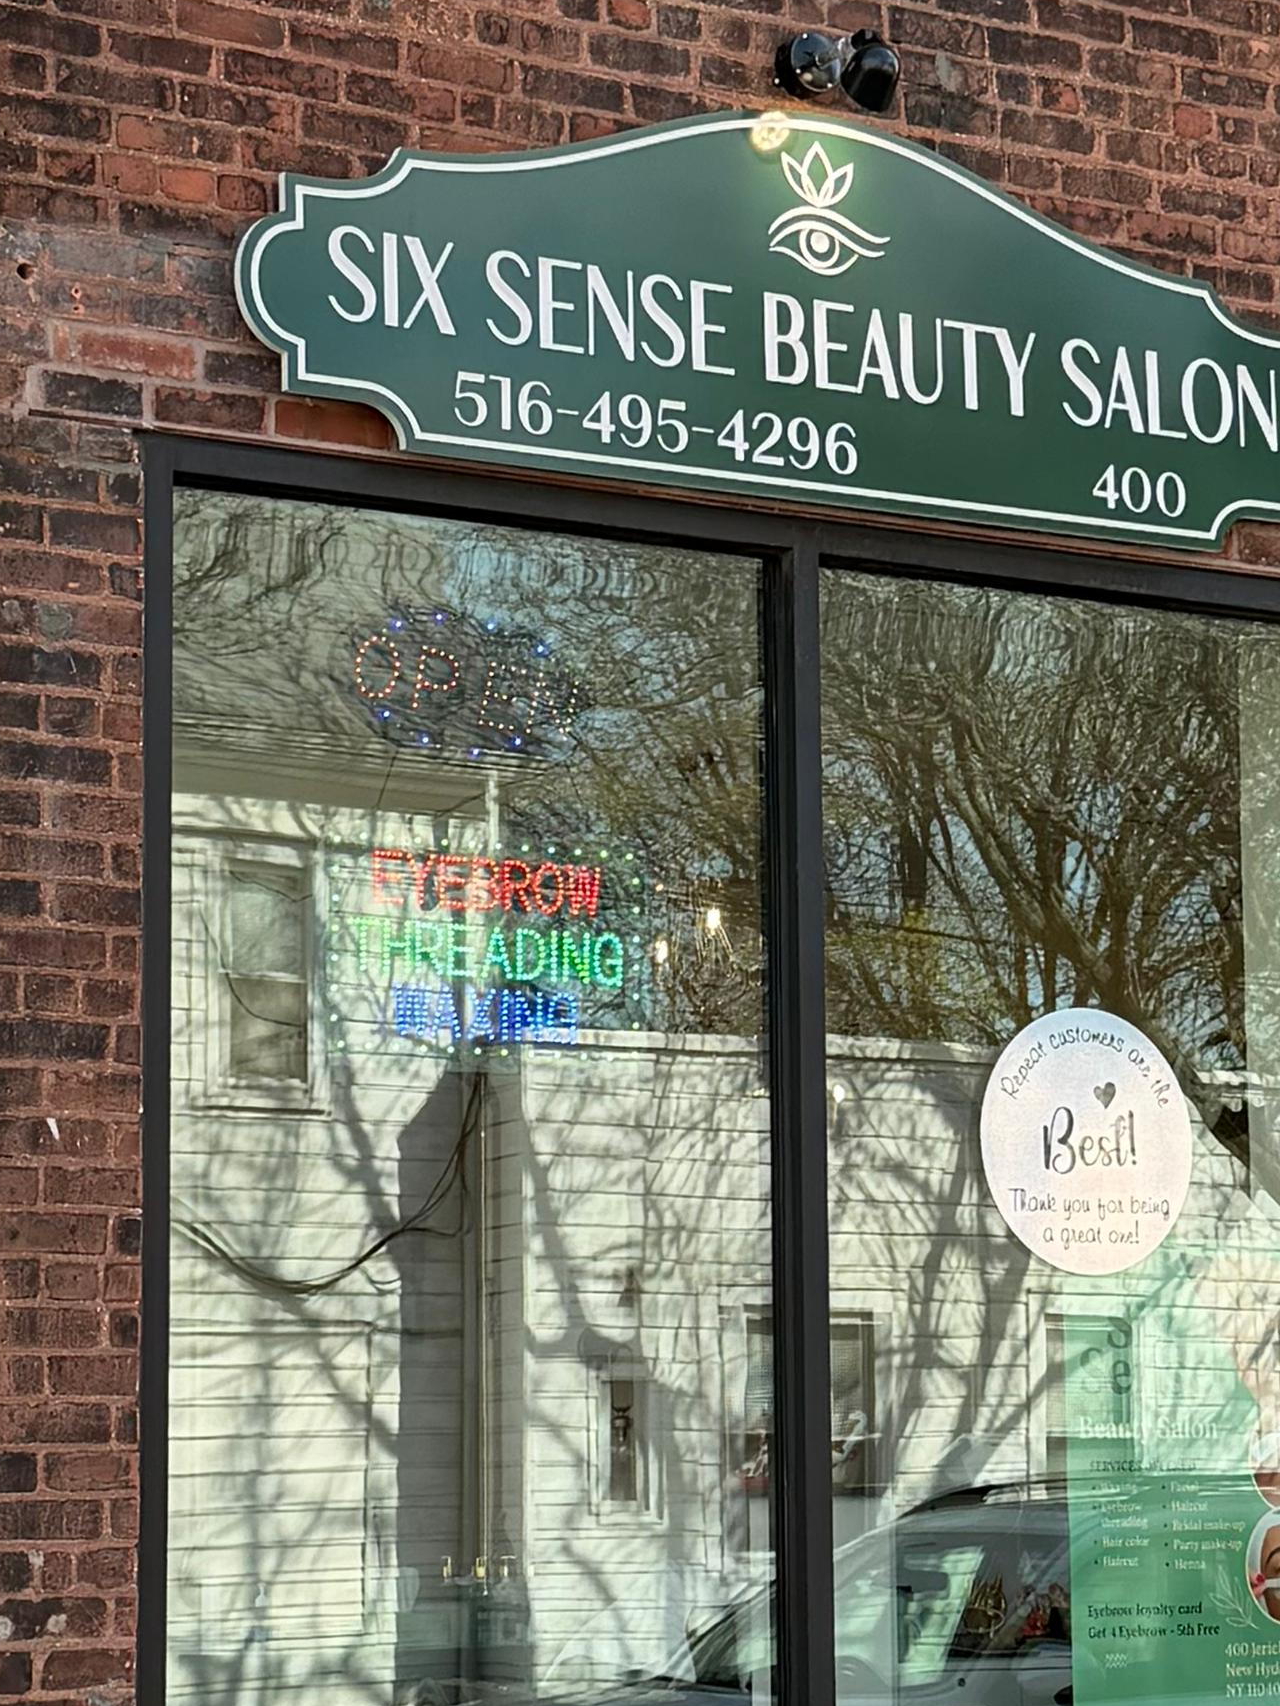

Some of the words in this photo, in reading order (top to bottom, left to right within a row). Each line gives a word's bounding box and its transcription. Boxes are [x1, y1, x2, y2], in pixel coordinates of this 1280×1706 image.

[328, 225, 455, 335] SIX
[487, 250, 735, 376] SENSE
[764, 293, 1035, 417] BEAUTY
[1061, 338, 1278, 452] SALON
[454, 372, 858, 475] 516-495-4296
[1093, 464, 1187, 518] 400
[354, 635, 580, 740] OPEN
[370, 849, 602, 918] EYEBROW
[348, 917, 625, 988] THREADING
[1043, 1106, 1138, 1174] Best!
[1008, 1188, 1057, 1212] Thank
[1063, 1199, 1090, 1220] you
[1098, 1198, 1124, 1220] for
[1131, 1196, 1169, 1221] being
[1043, 1227, 1053, 1243] a
[1061, 1227, 1101, 1250] great
[1158, 1417, 1218, 1438] Salon
[1178, 1602, 1202, 1615] card
[1197, 1624, 1220, 1636] Free
[1226, 1664, 1252, 1677] New
[1226, 1684, 1245, 1698] NY
